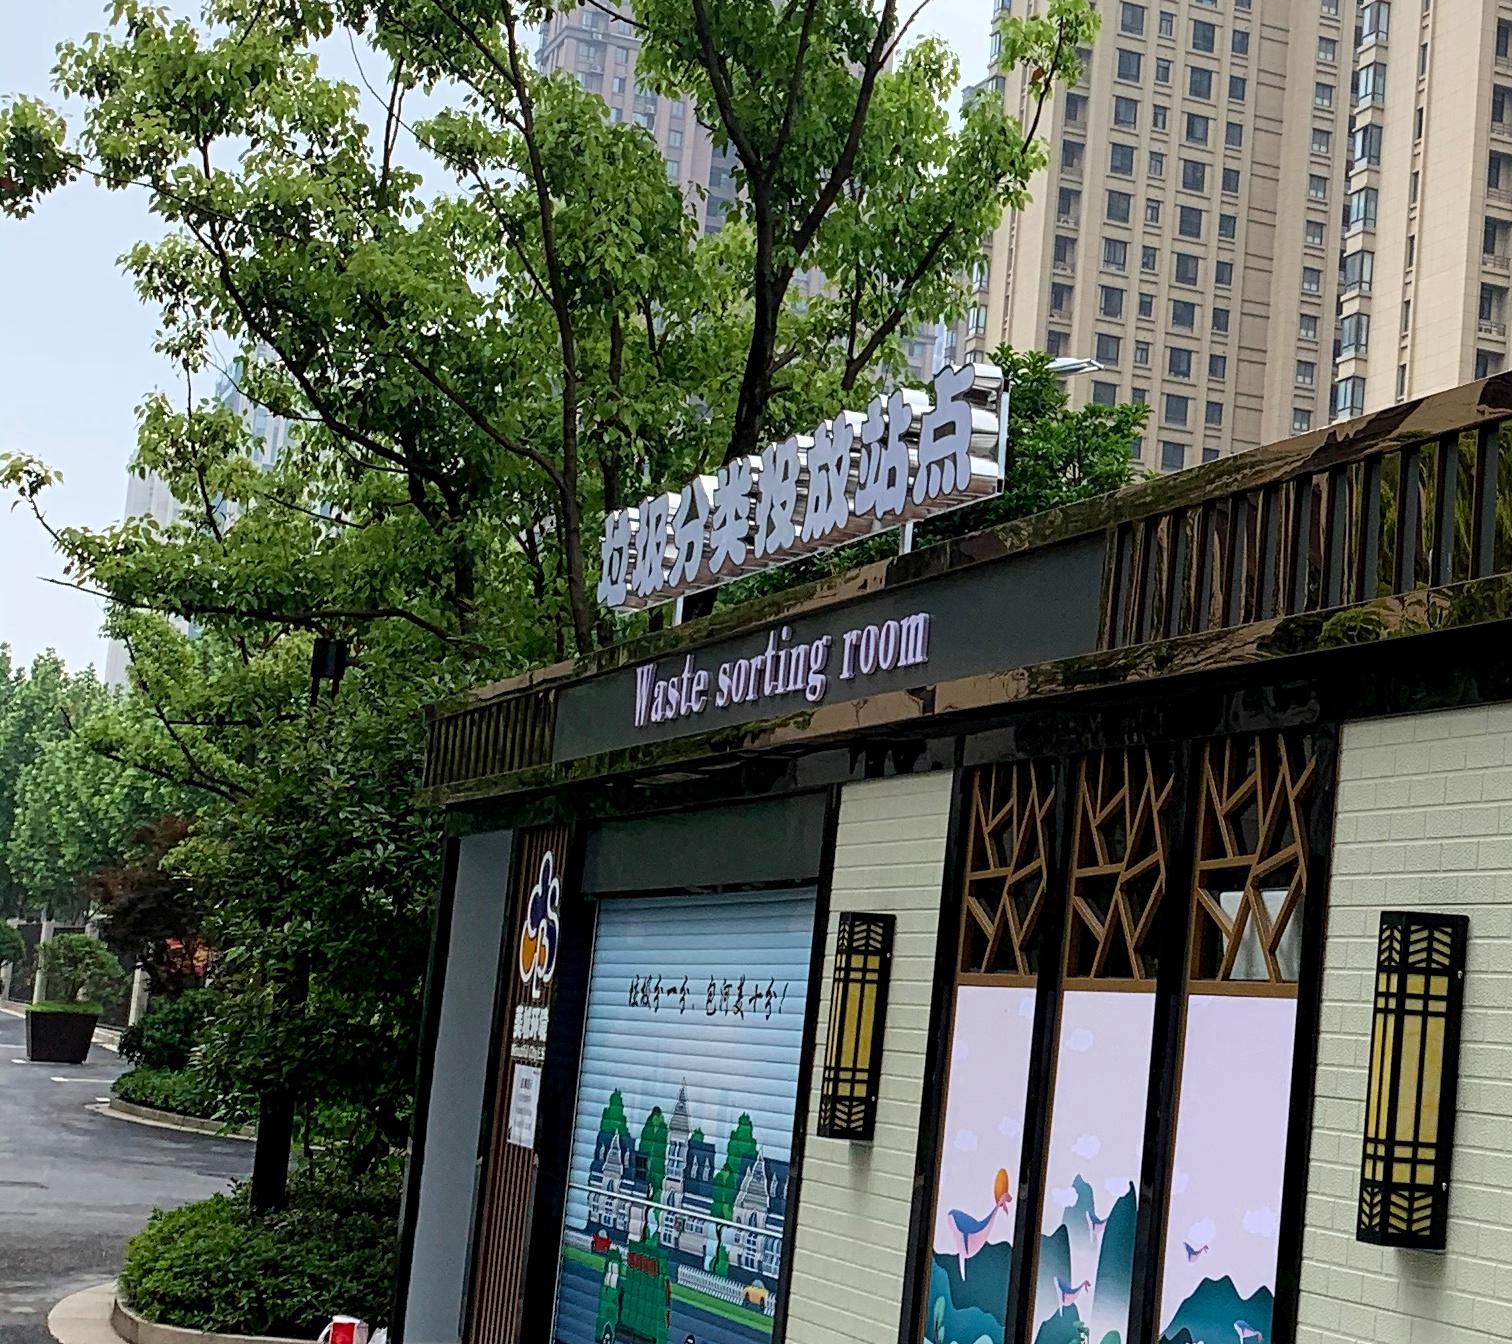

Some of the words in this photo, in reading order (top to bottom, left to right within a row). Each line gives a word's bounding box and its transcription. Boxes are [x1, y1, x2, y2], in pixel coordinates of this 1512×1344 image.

[597, 362, 978, 607] 垃圾分类投放站点
[634, 655, 708, 727] Waste
[715, 625, 831, 707] sorting
[840, 612, 930, 680] room
